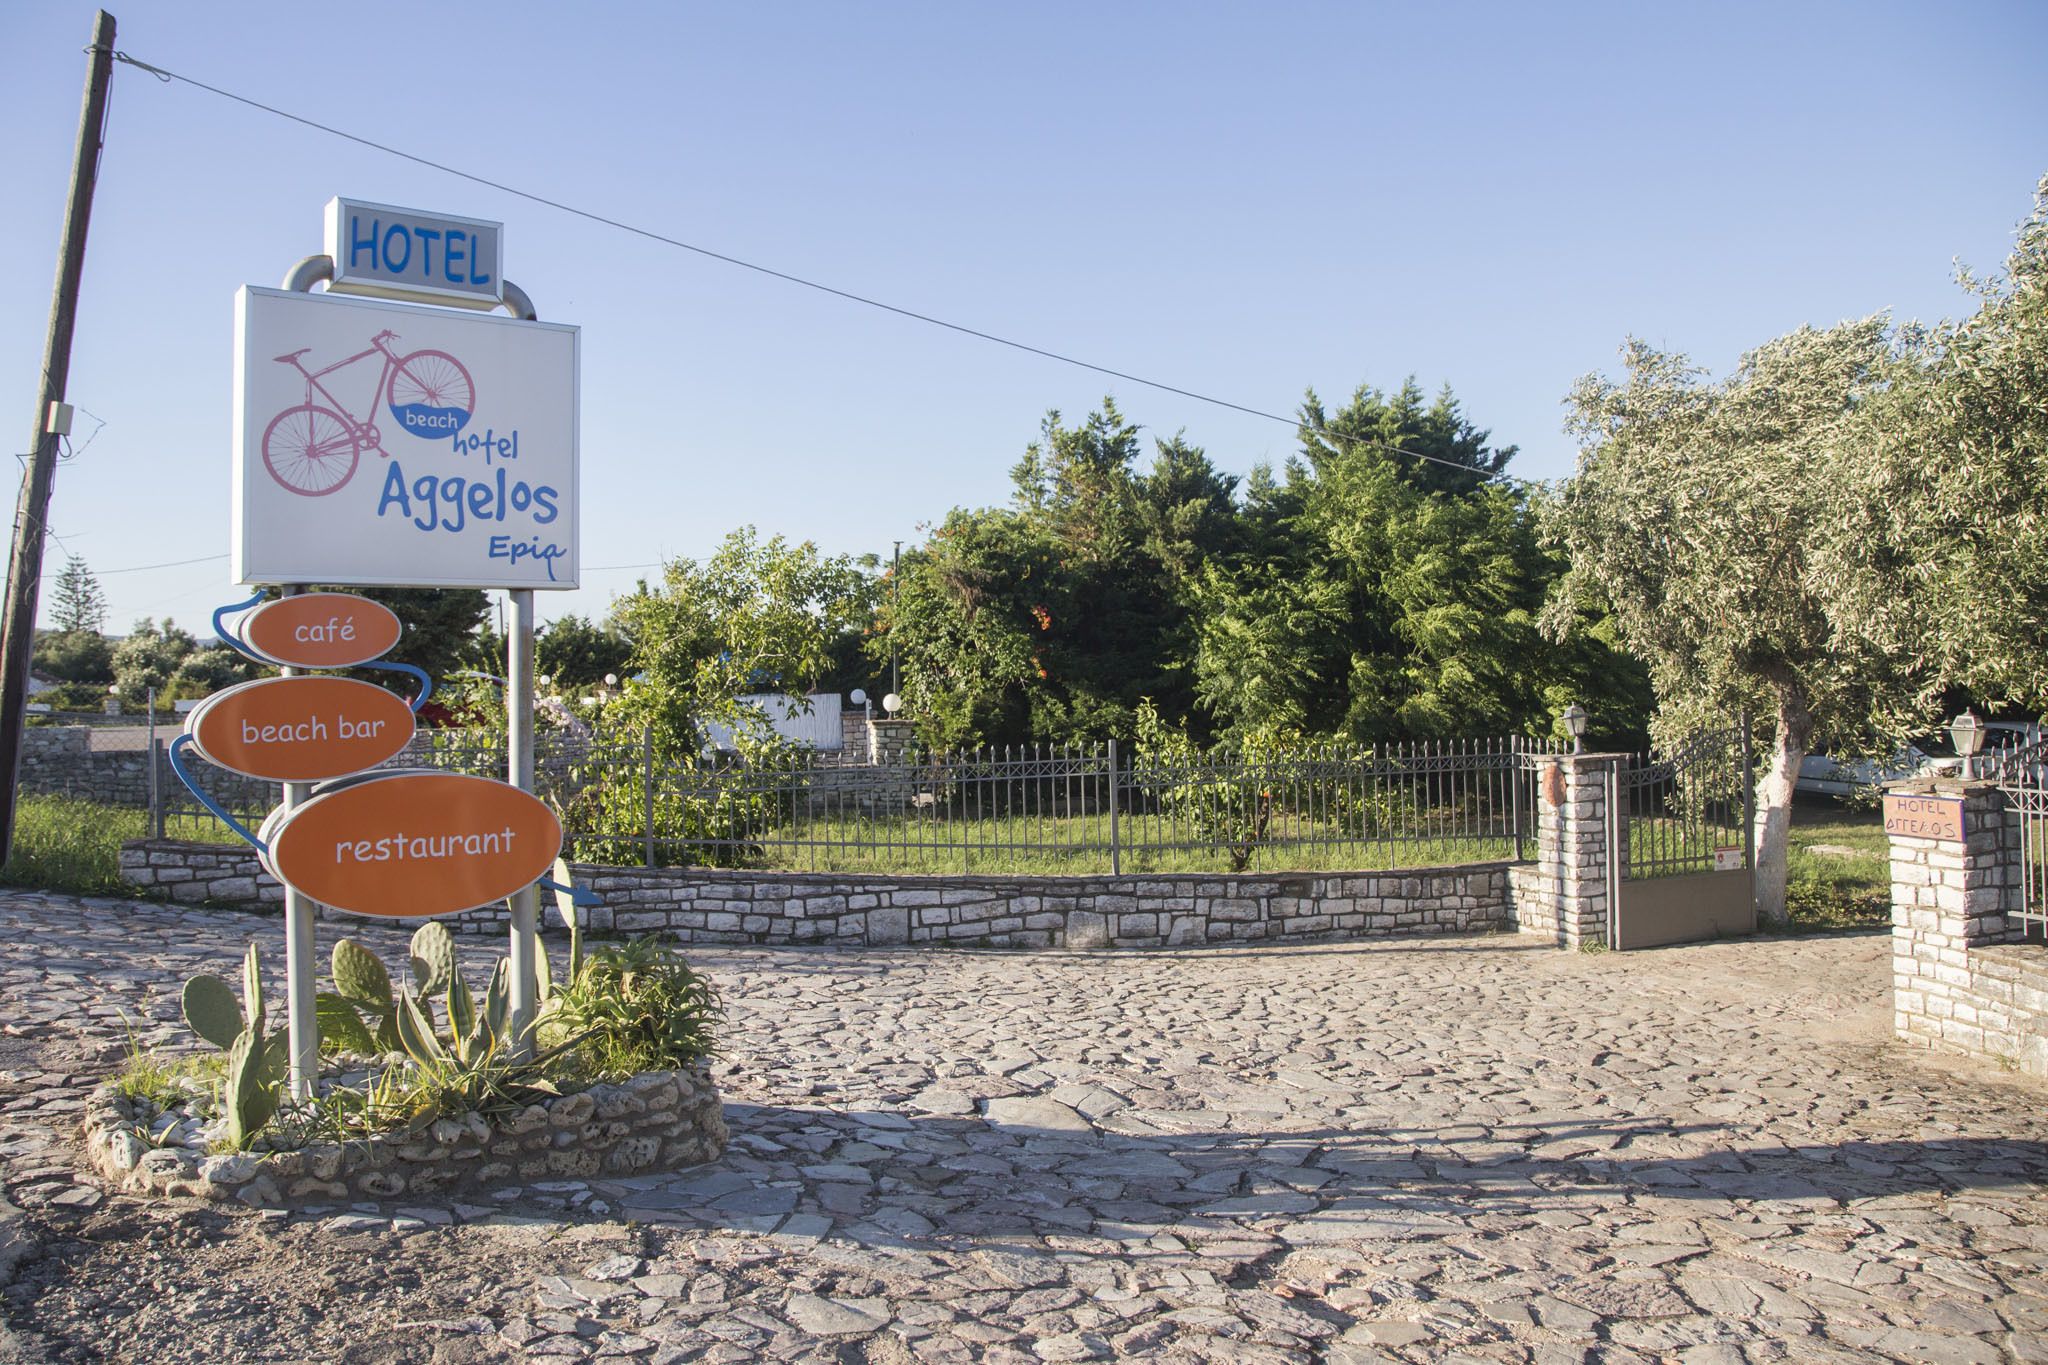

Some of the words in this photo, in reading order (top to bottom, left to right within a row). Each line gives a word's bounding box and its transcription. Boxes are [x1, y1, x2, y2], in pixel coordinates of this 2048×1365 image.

[351, 216, 490, 285] HOTEL
[406, 409, 458, 430] beach
[452, 429, 518, 465] hotel
[378, 460, 558, 533] Aggelos
[295, 617, 356, 643] café
[242, 715, 327, 744] beach
[339, 715, 385, 739] bar
[1897, 800, 1945, 815] HOTEL
[336, 827, 515, 863] restaurant
